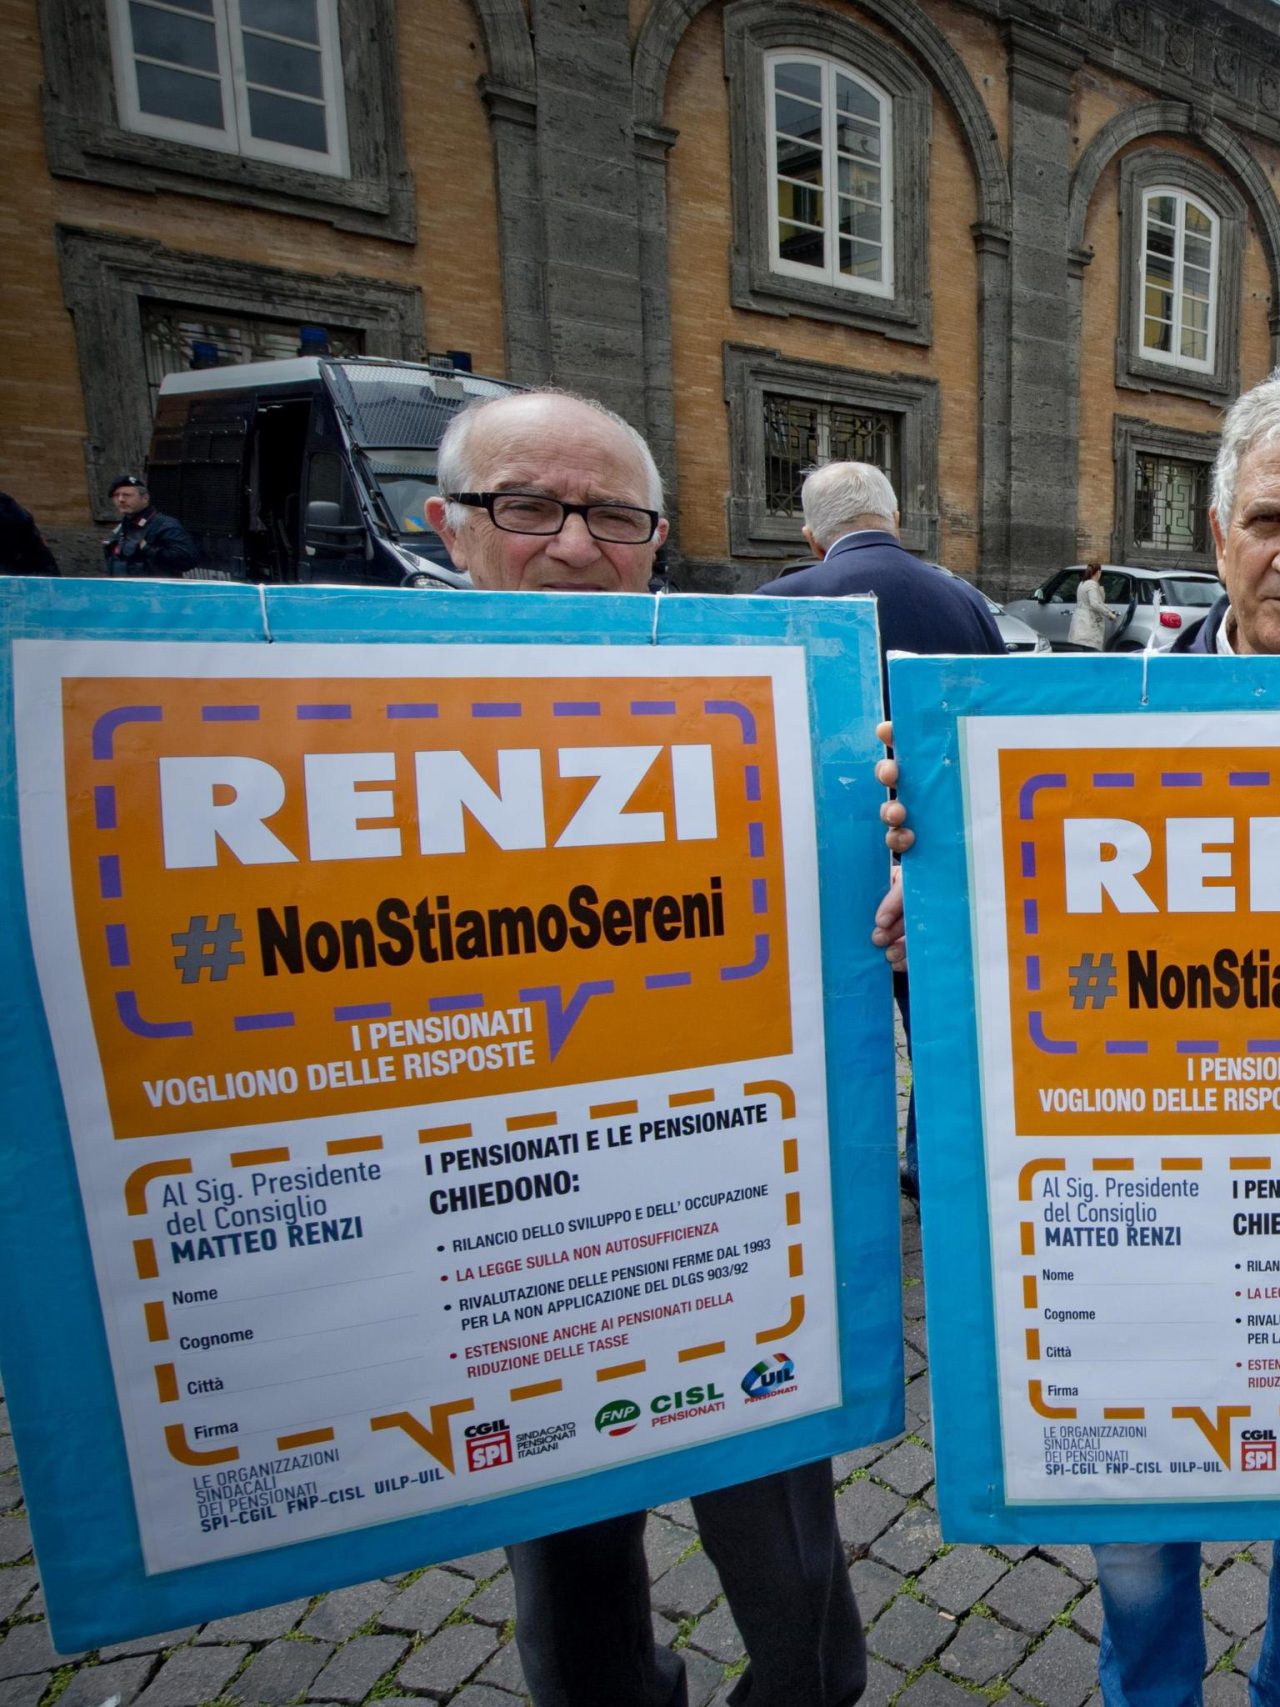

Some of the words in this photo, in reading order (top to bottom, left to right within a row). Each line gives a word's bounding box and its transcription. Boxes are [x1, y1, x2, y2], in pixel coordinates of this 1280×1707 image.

[159, 744, 718, 869] RENZI
[351, 1024, 361, 1051] I
[368, 1006, 532, 1049] PENSIONATI
[142, 1066, 298, 1107] VOGLIONO
[306, 1055, 396, 1090] DELLE
[402, 1039, 535, 1079] RISPOSTE
[1187, 1059, 1194, 1081] I
[1039, 1088, 1147, 1112] VOGLIONO
[1153, 1087, 1217, 1112] DELLE
[424, 1154, 433, 1175] I
[439, 1132, 579, 1173] PENSIONATI
[586, 1129, 600, 1151] E
[606, 1124, 632, 1147] LE
[639, 1103, 767, 1142] PENSIONATE
[162, 1183, 187, 1208] Al
[196, 1178, 243, 1206] Sig.
[252, 1162, 382, 1197] Presidente
[429, 1169, 580, 1215] CHIEDONO:
[1043, 1177, 1060, 1198] Al
[1066, 1177, 1098, 1203] Sig.
[1106, 1177, 1199, 1198] Presidente
[1232, 1180, 1238, 1198] I
[166, 1209, 206, 1236] del
[215, 1196, 327, 1231] Consiglio
[1044, 1202, 1070, 1223] del
[1077, 1202, 1157, 1227] Consiglio
[171, 1227, 278, 1264] MATTEO
[288, 1215, 363, 1249] RENZI
[1045, 1227, 1118, 1247] MATTEO
[1127, 1226, 1181, 1247] RENZI
[455, 1267, 475, 1282] LA
[477, 1258, 523, 1278] LEGGE
[526, 1250, 569, 1269] SULLA
[572, 1243, 601, 1260] NON
[605, 1221, 718, 1254] AUTOSUFFICIENZA
[1042, 1269, 1074, 1281] Nome
[172, 1287, 218, 1305] Nome
[1247, 1287, 1261, 1299] LA
[1044, 1308, 1096, 1322] Cognome
[180, 1327, 254, 1352] Cognome
[1247, 1332, 1268, 1344] PER
[1046, 1346, 1072, 1358] Città
[187, 1377, 224, 1395] Città
[761, 1368, 795, 1388] UIL
[650, 1383, 725, 1414] CISL
[1048, 1385, 1079, 1397] Firma
[600, 1405, 635, 1424] FNP
[194, 1421, 239, 1440] Firma
[464, 1419, 510, 1438] CGIL
[1044, 1427, 1057, 1439] LE
[1060, 1426, 1147, 1439] ORGANIZZAZIONI
[1241, 1430, 1277, 1440] CGIL
[1044, 1438, 1100, 1450] SINDACALI
[1045, 1451, 1062, 1463] DEI
[1065, 1450, 1129, 1463] PENSIONATI
[1045, 1463, 1099, 1475] SPI-CGIL
[1106, 1462, 1162, 1474] FNP-CISL
[1170, 1462, 1222, 1473] UILP-UIL
[201, 1507, 277, 1533] SPI-CGIL
[287, 1487, 365, 1514] FNP-CISL
[374, 1467, 444, 1495] UILP-UIL
